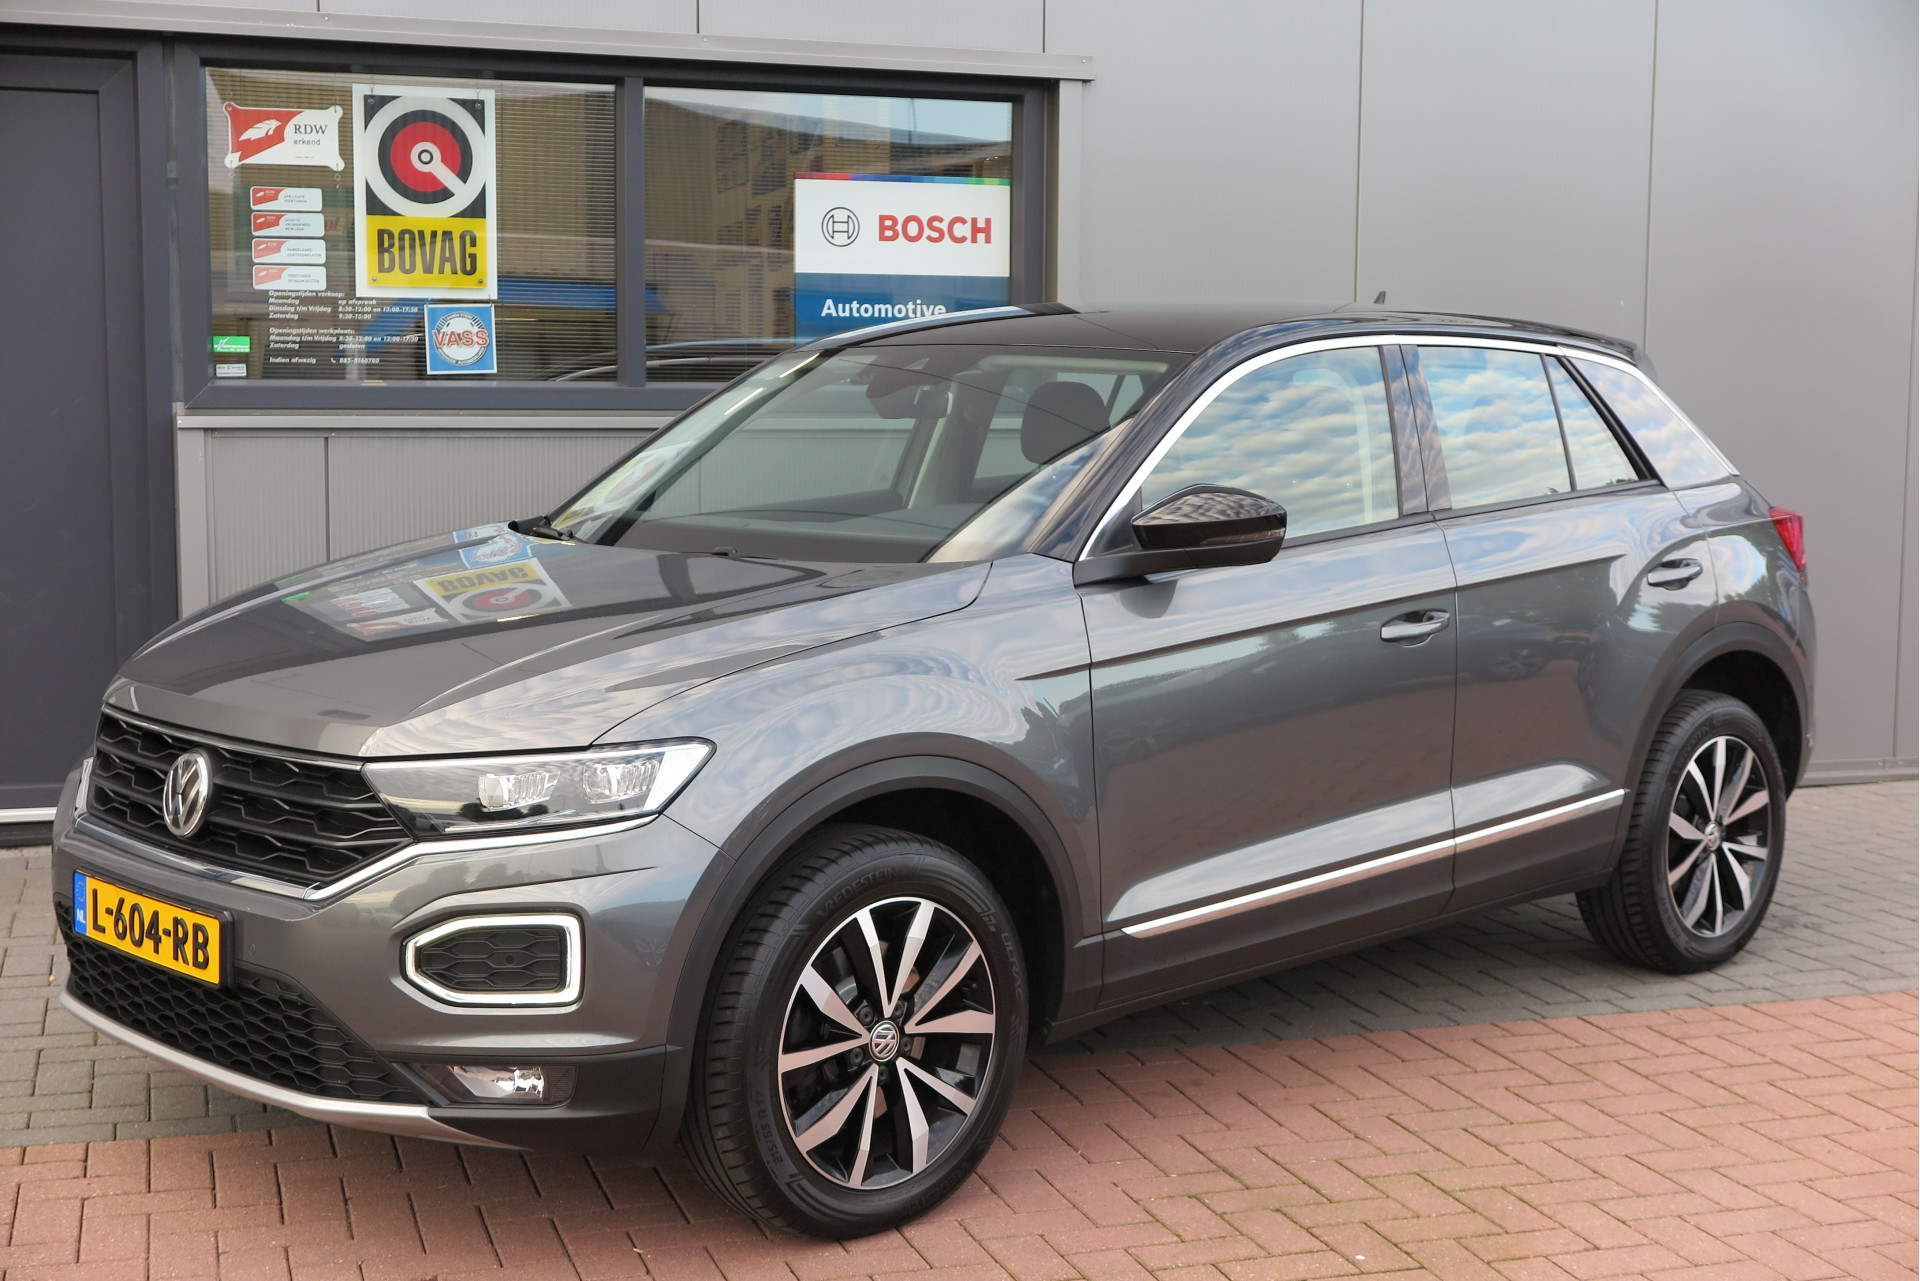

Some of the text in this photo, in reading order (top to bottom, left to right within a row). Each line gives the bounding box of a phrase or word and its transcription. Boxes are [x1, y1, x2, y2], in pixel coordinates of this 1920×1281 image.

[293, 124, 327, 135] RDW
[293, 138, 321, 146] erkend
[878, 214, 992, 244] BOSCH
[377, 228, 477, 276] BOVAG
[268, 290, 316, 298] Openingstijden
[348, 298, 377, 306] afspraak
[821, 298, 947, 318] Automotive
[432, 329, 490, 347] VASS
[76, 909, 87, 924] NL
[92, 888, 210, 970] L-604-RB
